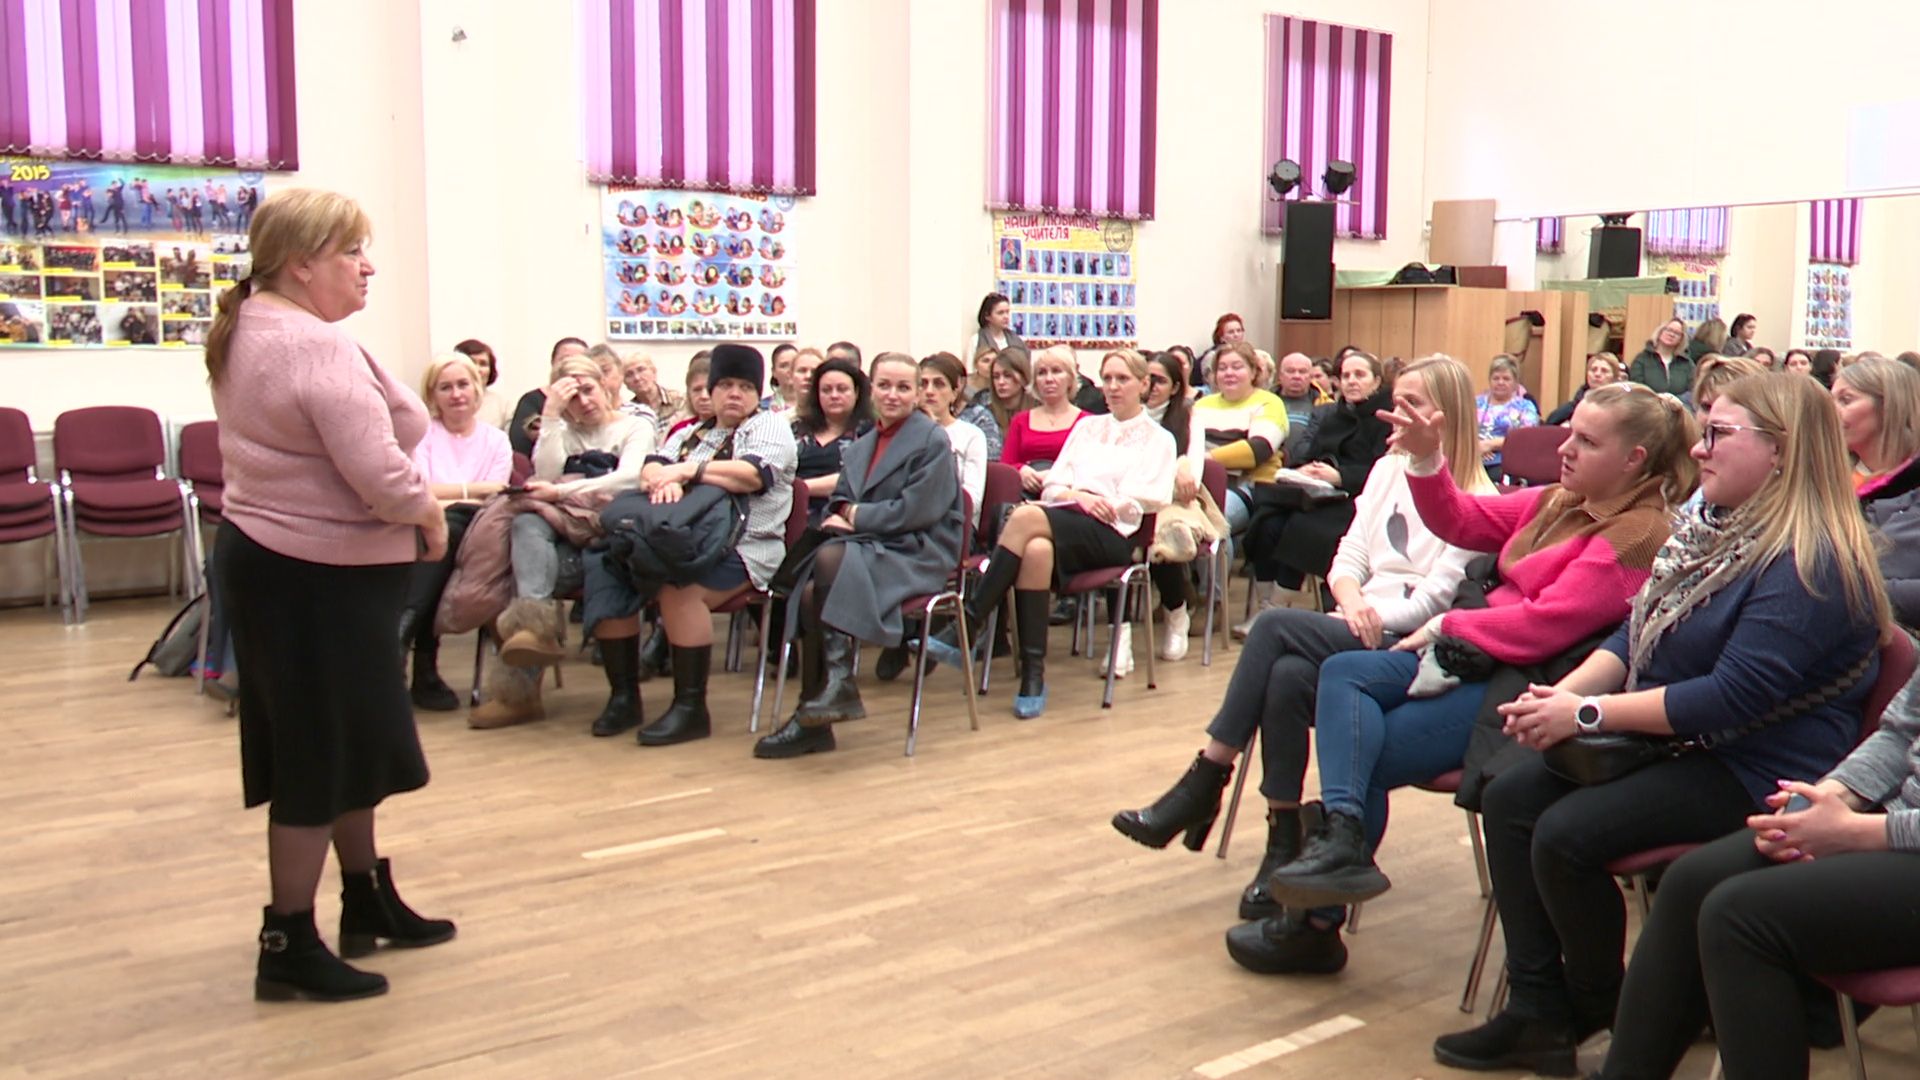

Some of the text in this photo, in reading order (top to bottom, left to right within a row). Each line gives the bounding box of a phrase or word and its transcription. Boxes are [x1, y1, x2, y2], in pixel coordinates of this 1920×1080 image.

[11, 165, 50, 181] 2015
[1003, 215, 1038, 230] НАШИ
[1022, 227, 1070, 242] УЧИТЕЛЯ
